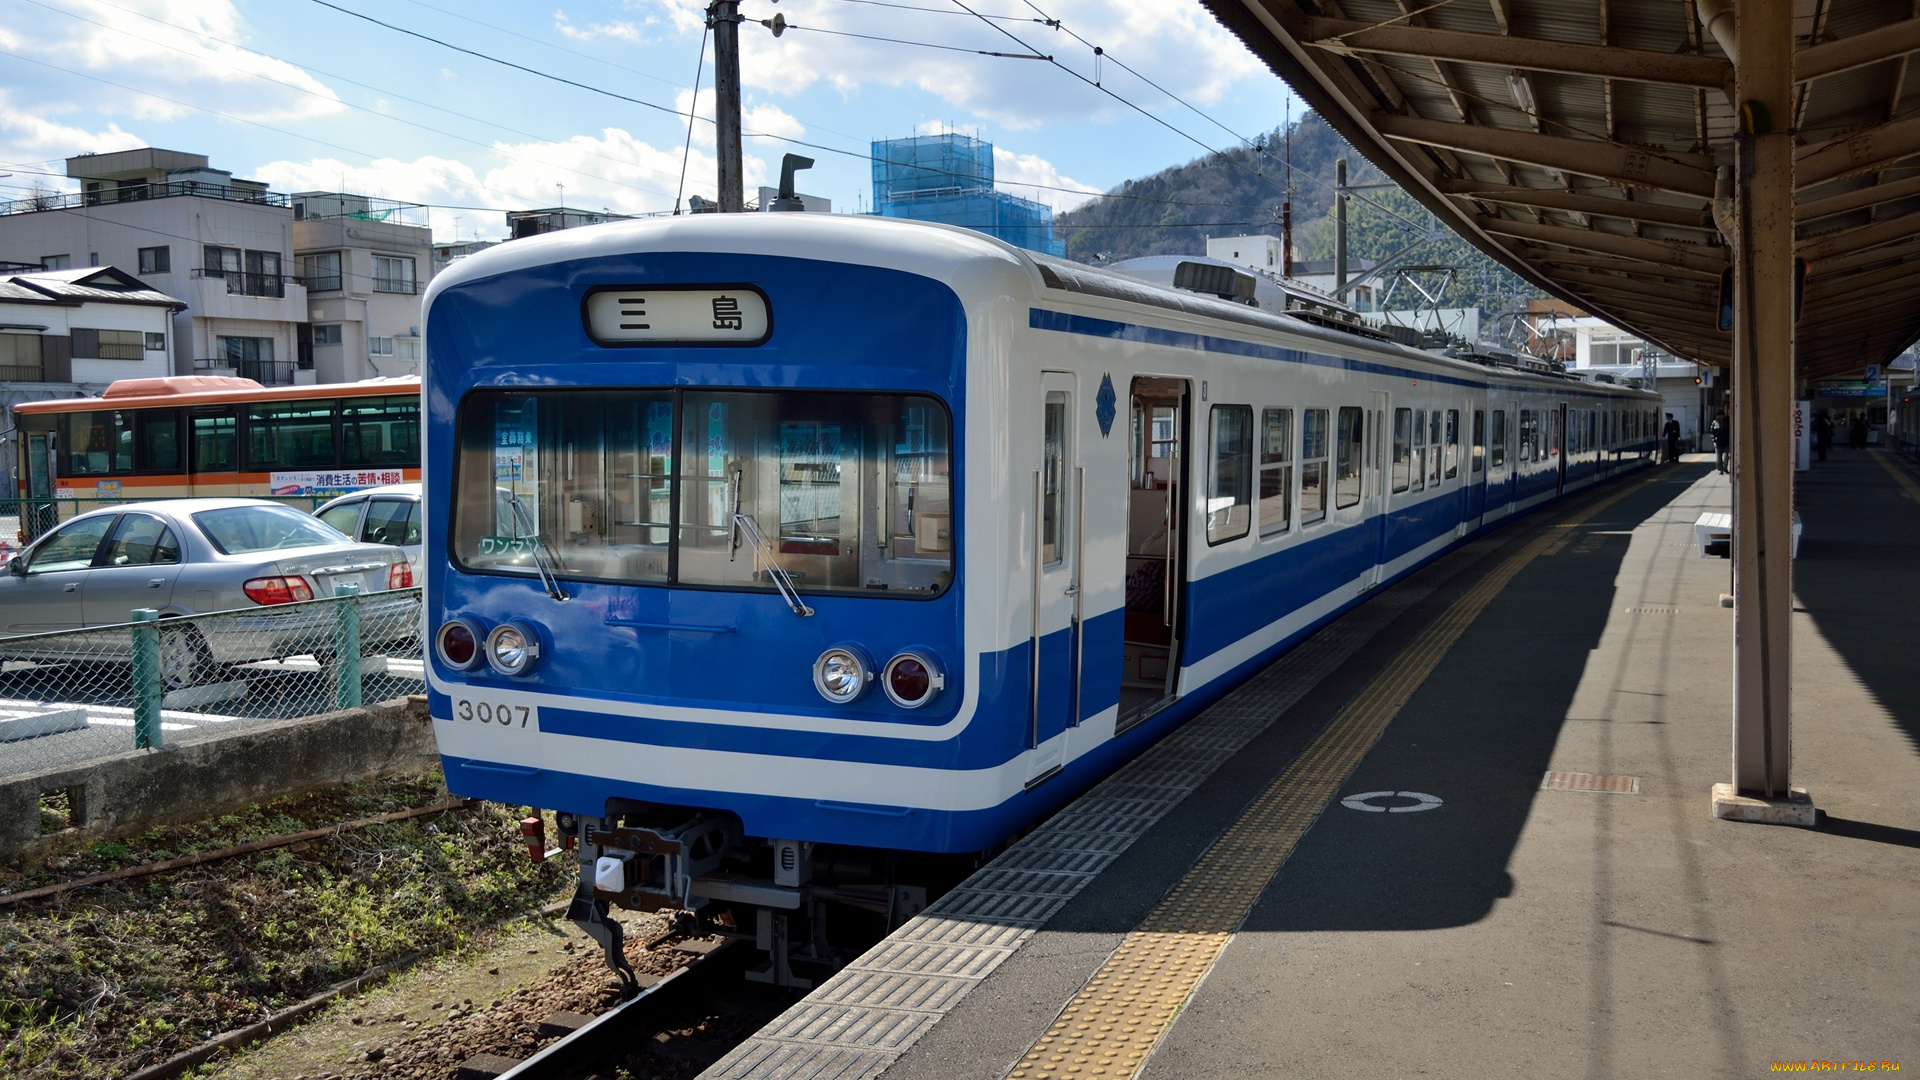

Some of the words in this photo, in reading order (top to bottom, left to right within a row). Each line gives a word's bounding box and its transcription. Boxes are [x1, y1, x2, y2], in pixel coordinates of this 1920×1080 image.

[1701, 370, 1709, 386] 1
[1866, 366, 1877, 382] 2
[316, 472, 401, 487] 消費生活の苦情・相談
[458, 699, 530, 729] 3007
